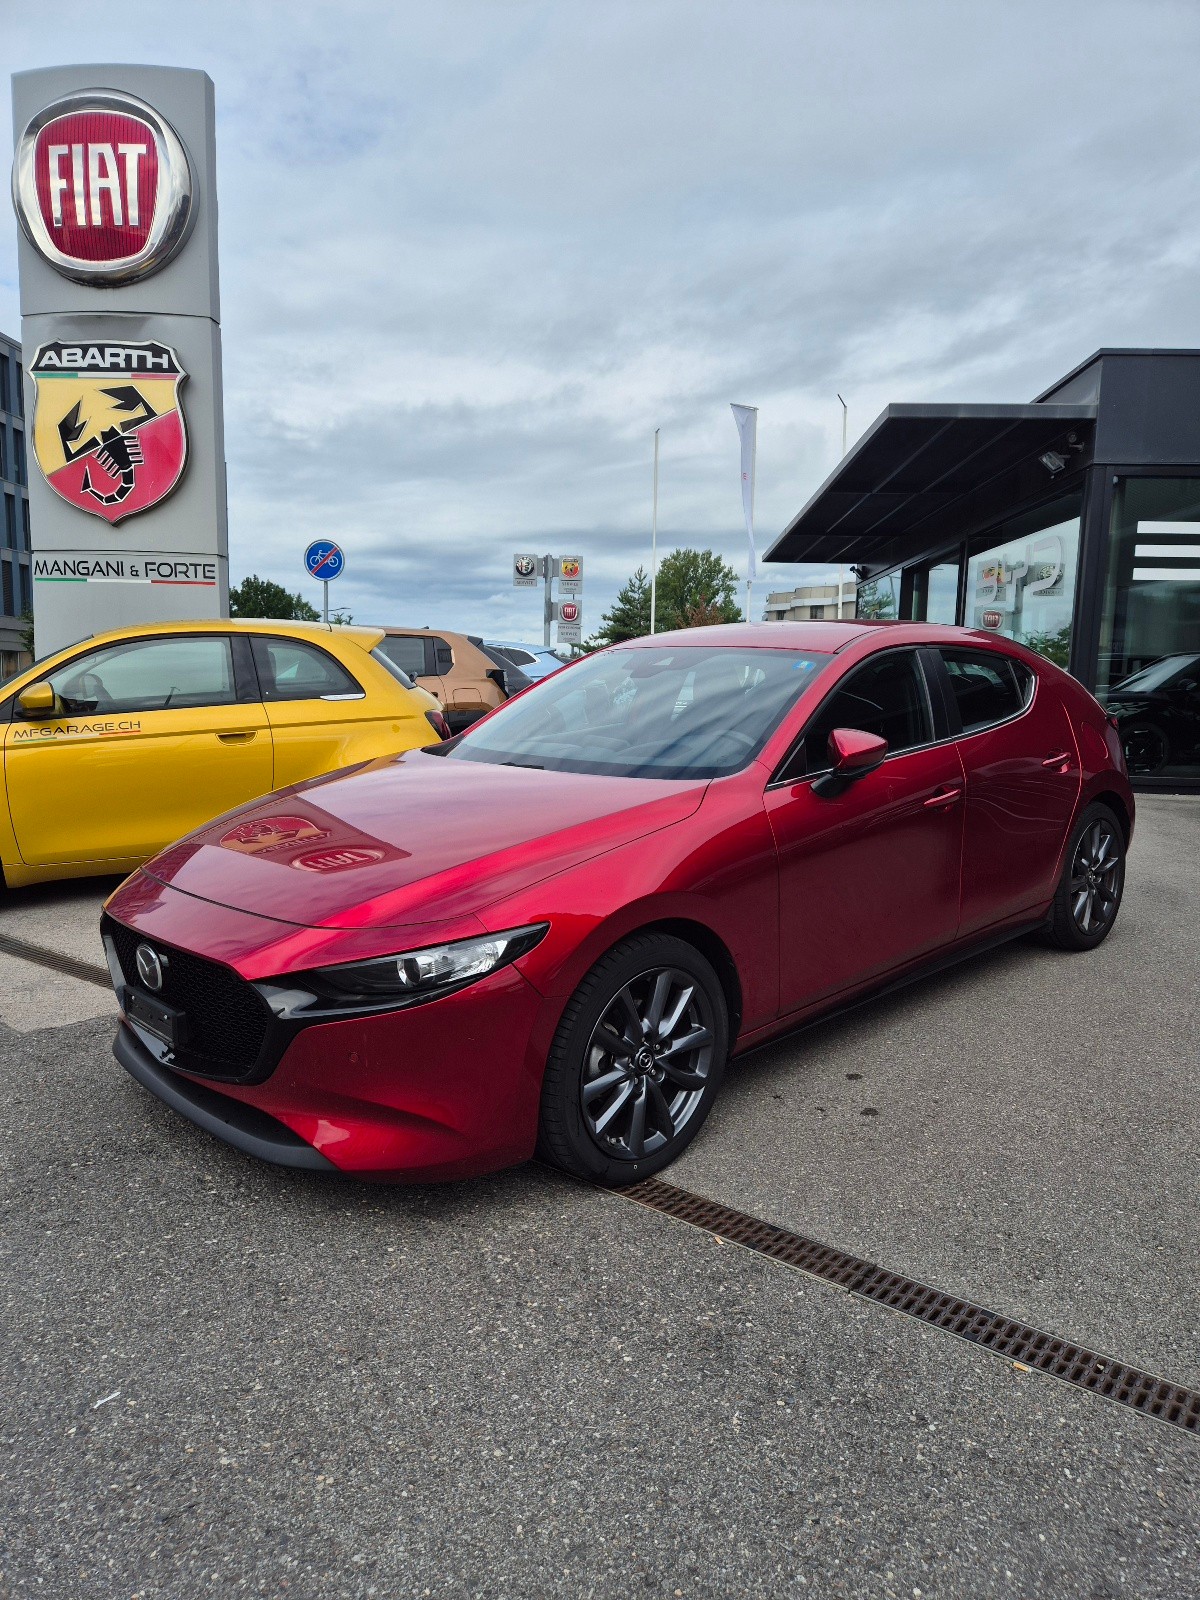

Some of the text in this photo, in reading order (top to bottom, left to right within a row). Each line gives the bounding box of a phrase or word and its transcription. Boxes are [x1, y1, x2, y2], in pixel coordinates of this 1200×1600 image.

[48, 143, 147, 226] FIAT
[39, 347, 169, 369] ABARTH
[34, 560, 216, 579] MANGANI & FORTE
[14, 720, 141, 739] MFGARAGE.CH
